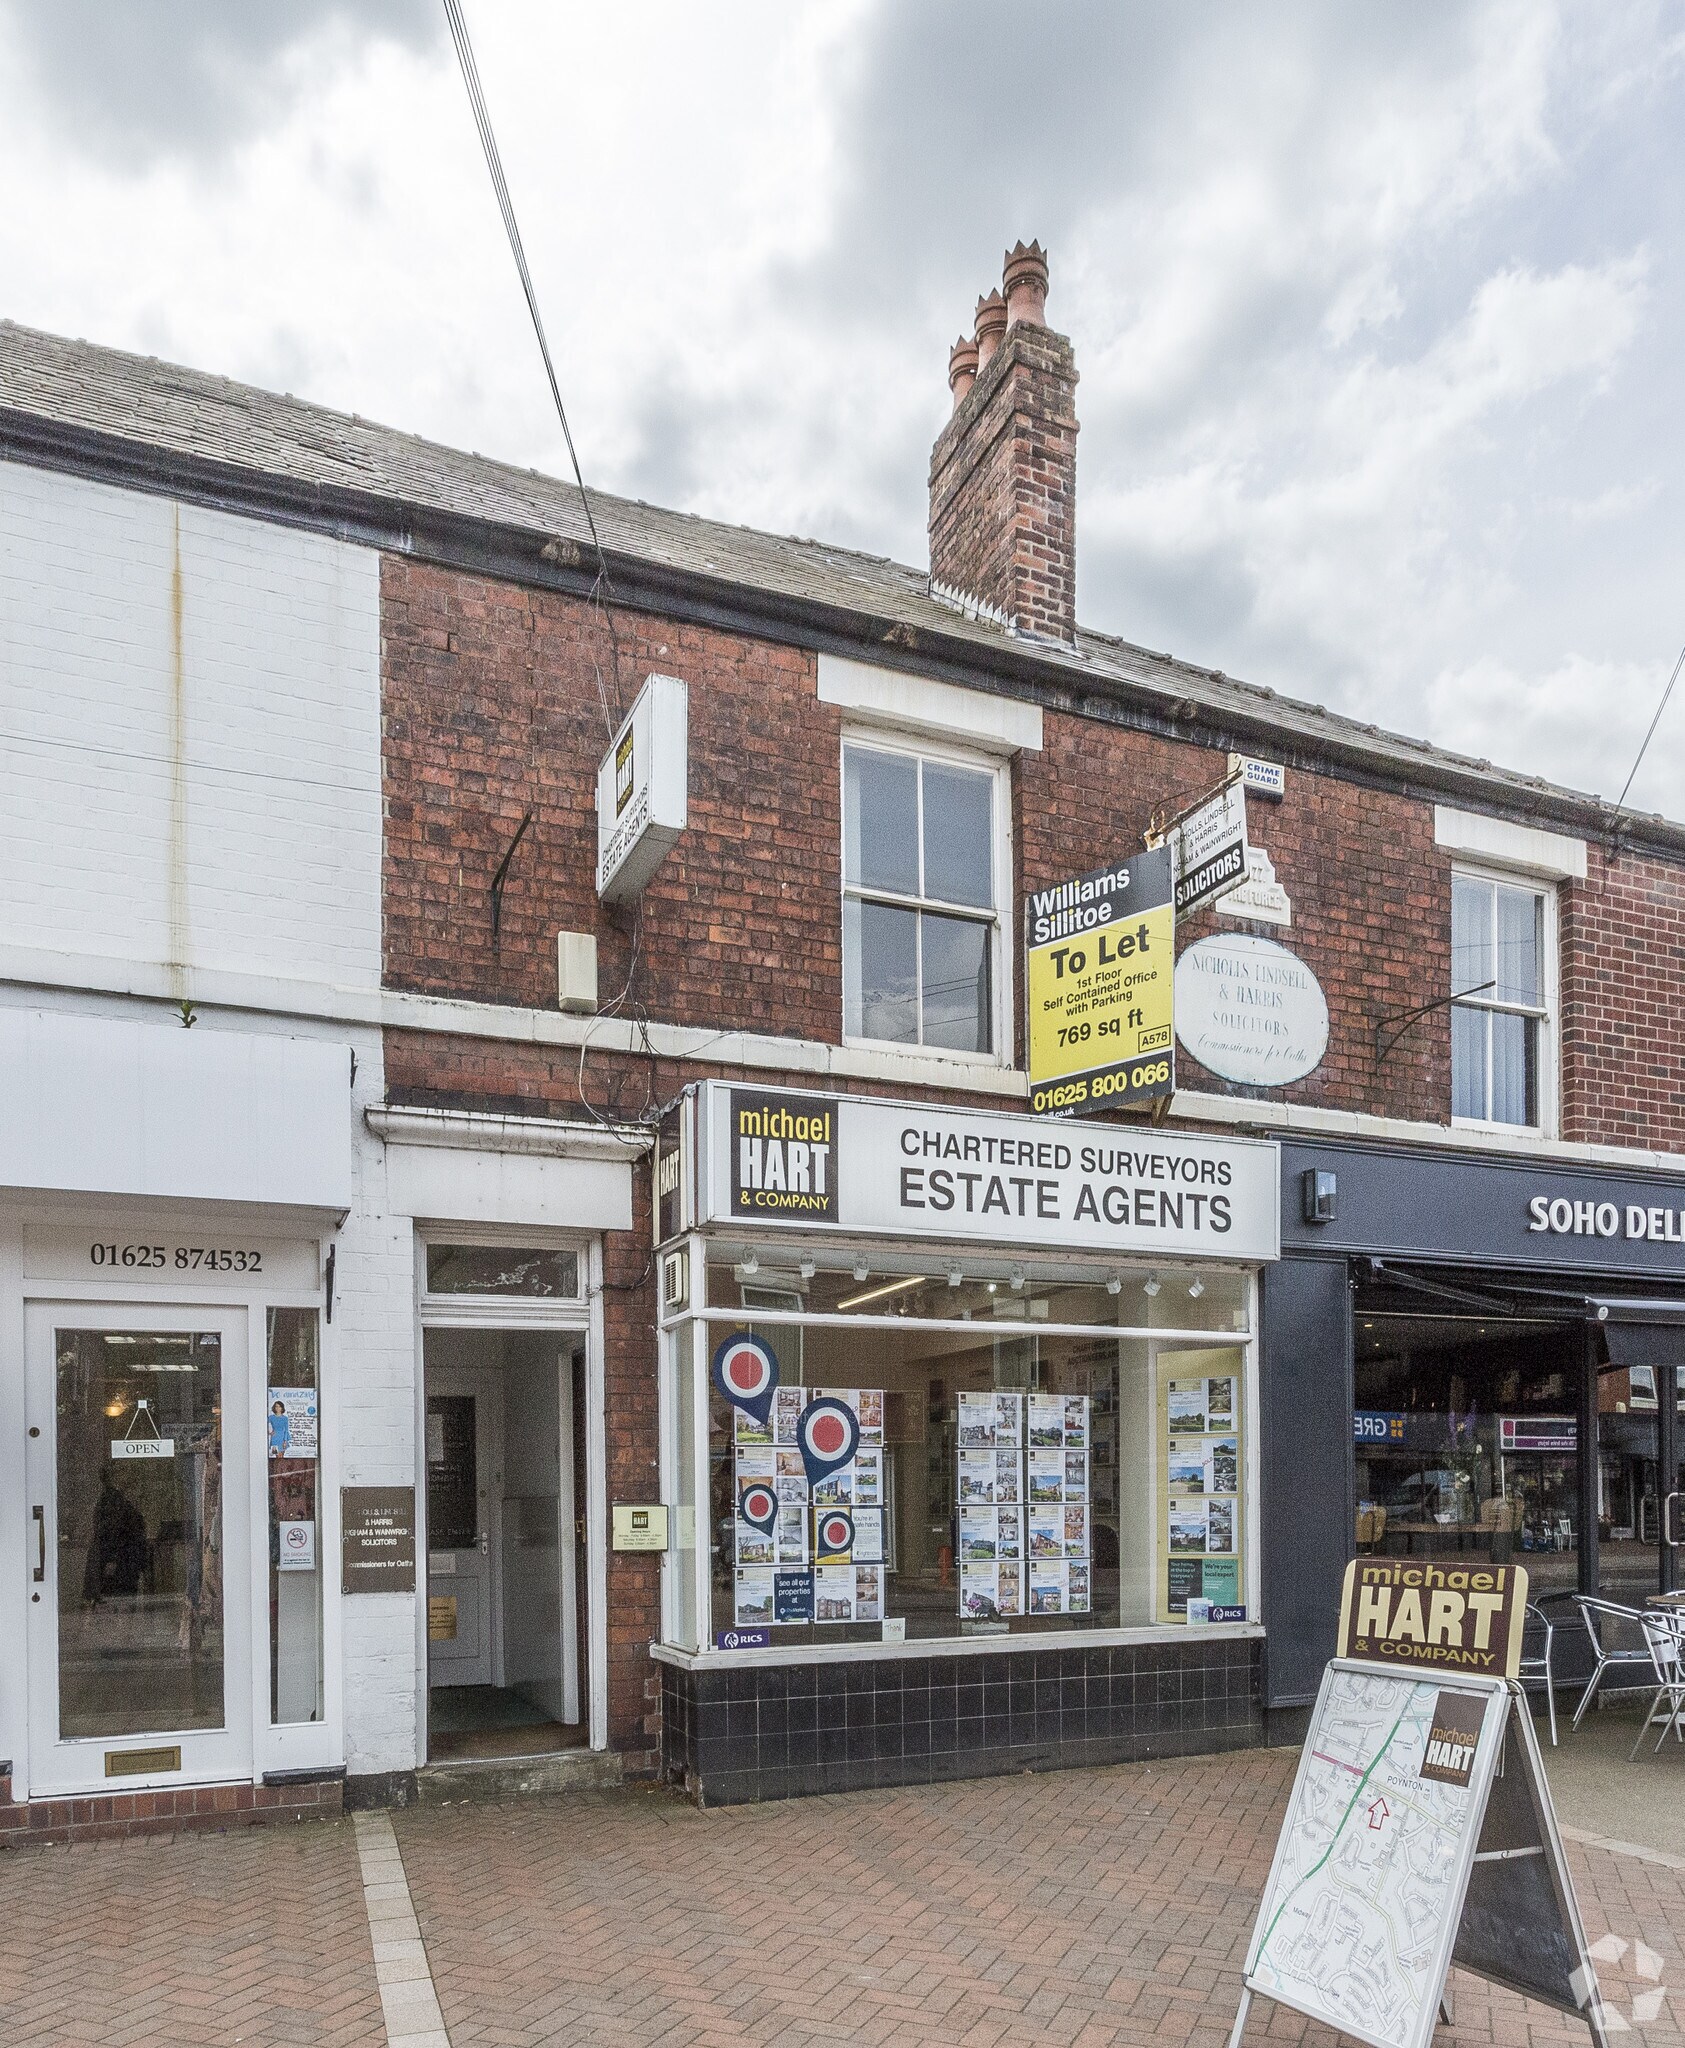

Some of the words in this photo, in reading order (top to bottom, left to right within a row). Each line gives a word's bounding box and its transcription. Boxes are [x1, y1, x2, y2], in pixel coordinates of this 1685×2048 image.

[1247, 763, 1280, 777] CRIME
[1247, 772, 1279, 785] GUARD
[1204, 799, 1235, 825] LINDSELL
[1195, 822, 1218, 844] HARRIS
[1200, 821, 1242, 854] WAINWRIGHT
[1176, 849, 1241, 905] SOLICITORS
[1033, 868, 1130, 917] Williams
[1035, 902, 1112, 943] Sillitoe
[1050, 947, 1086, 979] To
[1099, 924, 1150, 966] Let
[1043, 995, 1063, 1011] Self
[1066, 980, 1120, 1004] Contained
[1124, 970, 1158, 988] Office
[1077, 976, 1092, 989] 1st
[1095, 969, 1122, 985] Floor
[1256, 964, 1308, 990] LINDSELL
[1066, 1001, 1088, 1017] with
[1092, 990, 1133, 1010] Parking
[1219, 983, 1229, 1000] &
[1237, 985, 1283, 1008] HARRIS
[1057, 1022, 1091, 1047] 769
[1097, 1017, 1120, 1037] sq
[1128, 1008, 1143, 1029] ft
[1212, 1010, 1289, 1036] SOLICITORS
[1141, 1031, 1168, 1047] A578
[1034, 1081, 1087, 1112] 01625
[1091, 1071, 1127, 1098] 800
[1131, 1060, 1170, 1089] 066
[739, 1106, 830, 1142] michael
[739, 1136, 830, 1194] HART
[900, 1128, 1072, 1170] CHARTERED
[1080, 1147, 1232, 1186] SURVEYORS
[660, 1149, 679, 1197] HART
[740, 1190, 751, 1205] &
[755, 1192, 829, 1210] COMPANY
[900, 1166, 1060, 1220] ESTATE
[1073, 1184, 1232, 1234] AGENTS
[1529, 1196, 1619, 1237] SOHO
[90, 1243, 167, 1268] 01625
[174, 1247, 262, 1272] 874532
[125, 1443, 160, 1454] OPEN
[364, 1518, 370, 1526] &
[370, 1518, 393, 1526] HARRIS
[362, 1538, 398, 1546] SOLICITORS
[1362, 1564, 1505, 1591] michael
[778, 1588, 810, 1596] properties
[1224, 1610, 1241, 1618] RICS
[1356, 1585, 1504, 1650] HART
[740, 1634, 762, 1644] RICS
[1355, 1639, 1369, 1652] &
[1380, 1641, 1495, 1666] COMPANY
[1432, 1727, 1478, 1746] michael
[1425, 1740, 1475, 1772] HART
[1387, 1775, 1424, 1791] POYNTON
[1431, 1765, 1466, 1778] COMPANY
